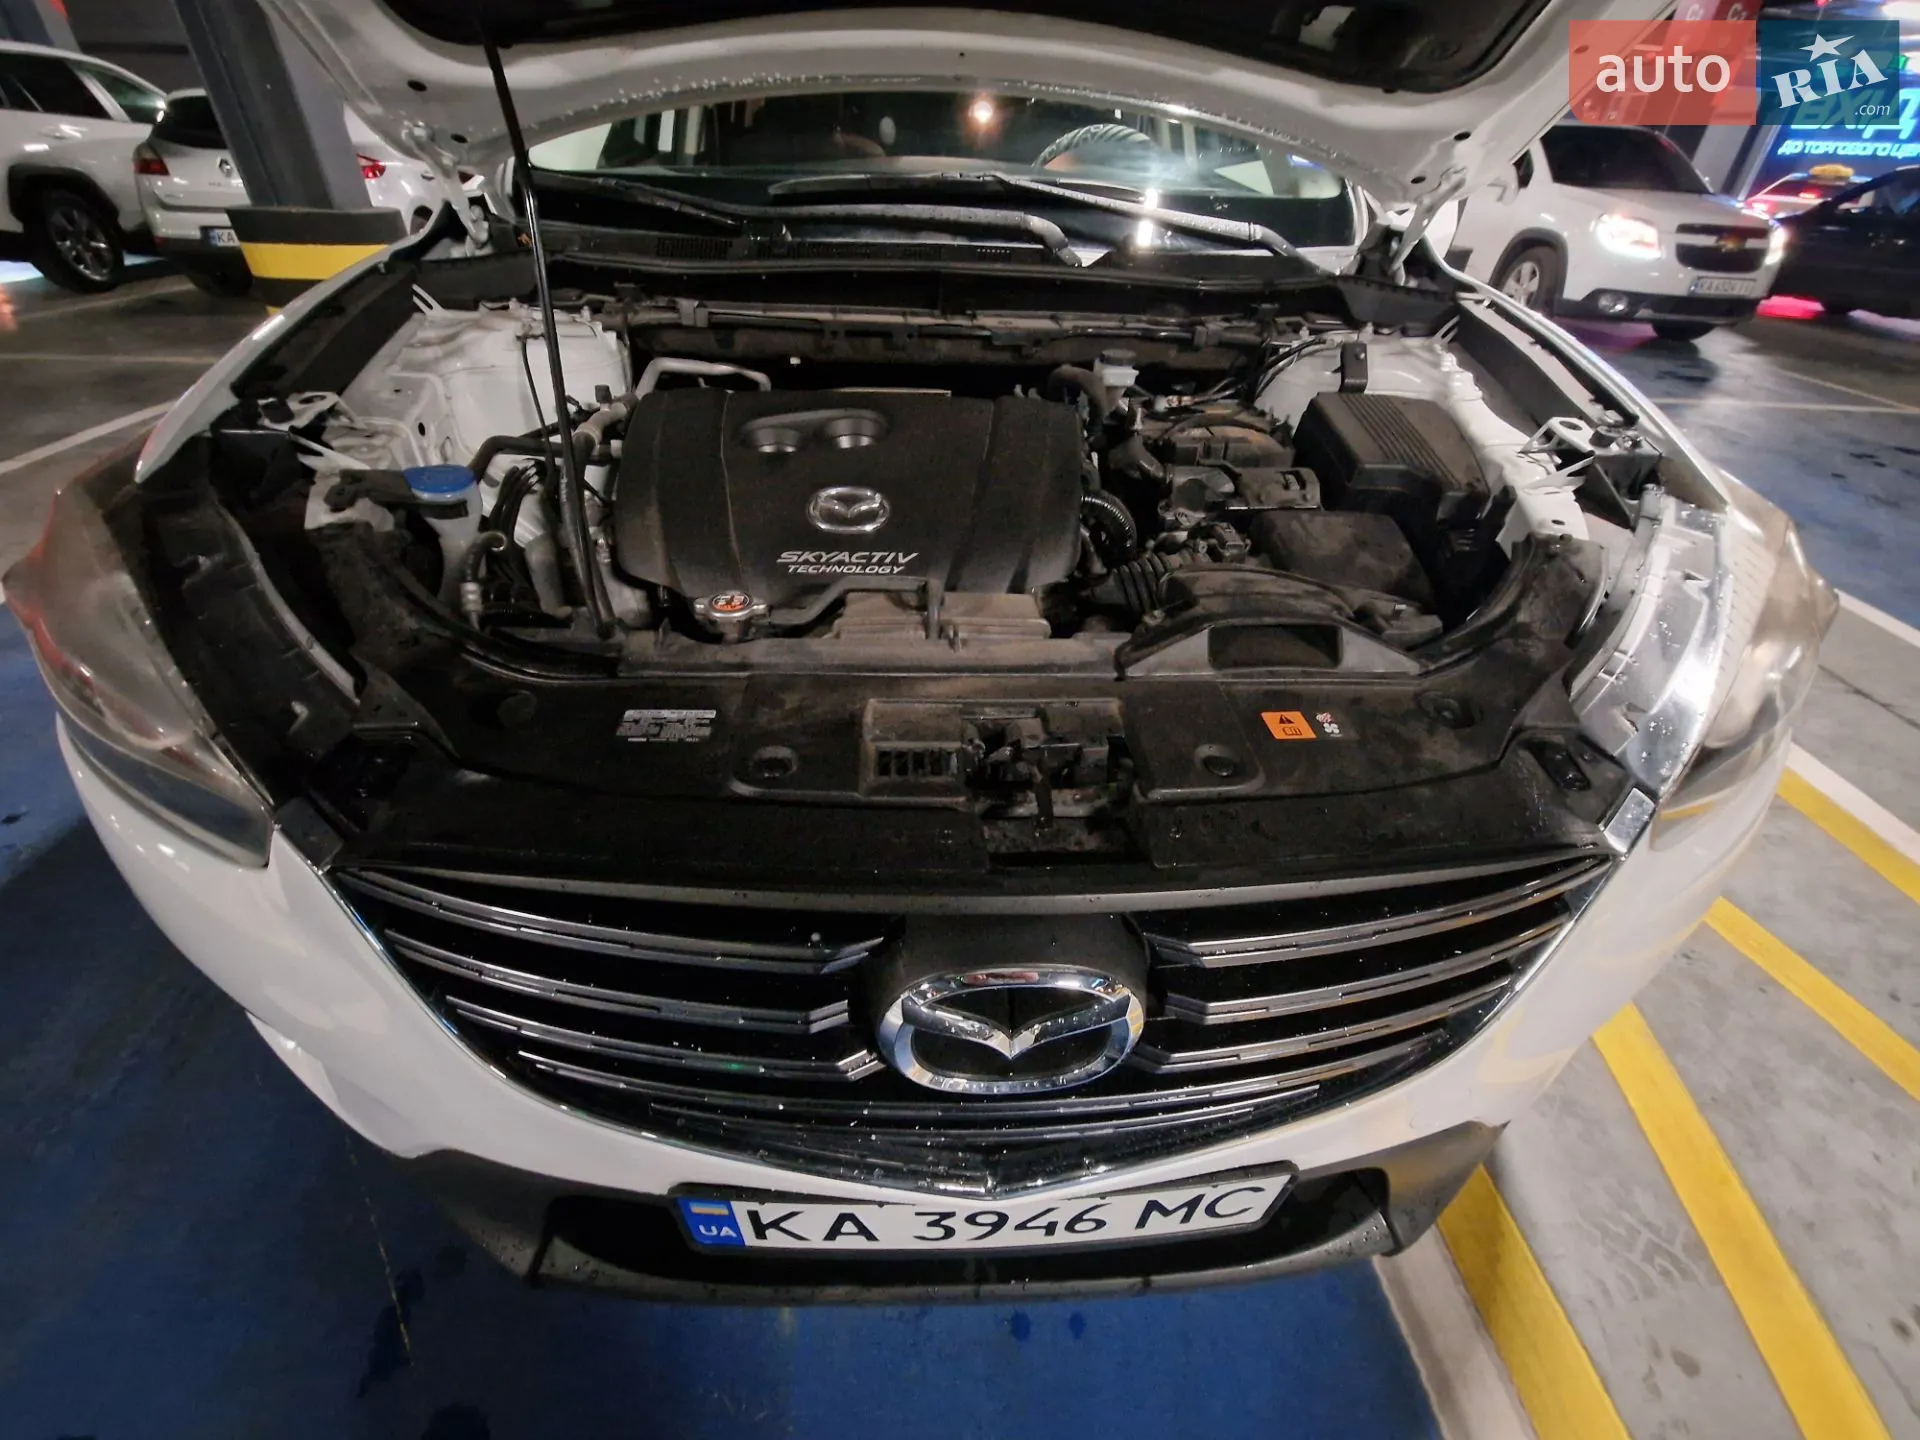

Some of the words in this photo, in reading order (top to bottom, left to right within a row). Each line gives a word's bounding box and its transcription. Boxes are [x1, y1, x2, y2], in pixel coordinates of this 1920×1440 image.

[776, 550, 919, 564] SKYACTIV
[787, 564, 905, 575] TECHNOLOGY
[746, 1209, 880, 1242] KA
[912, 1203, 1107, 1241] 3946
[1134, 1186, 1266, 1230] MC
[698, 1224, 738, 1238] UA
